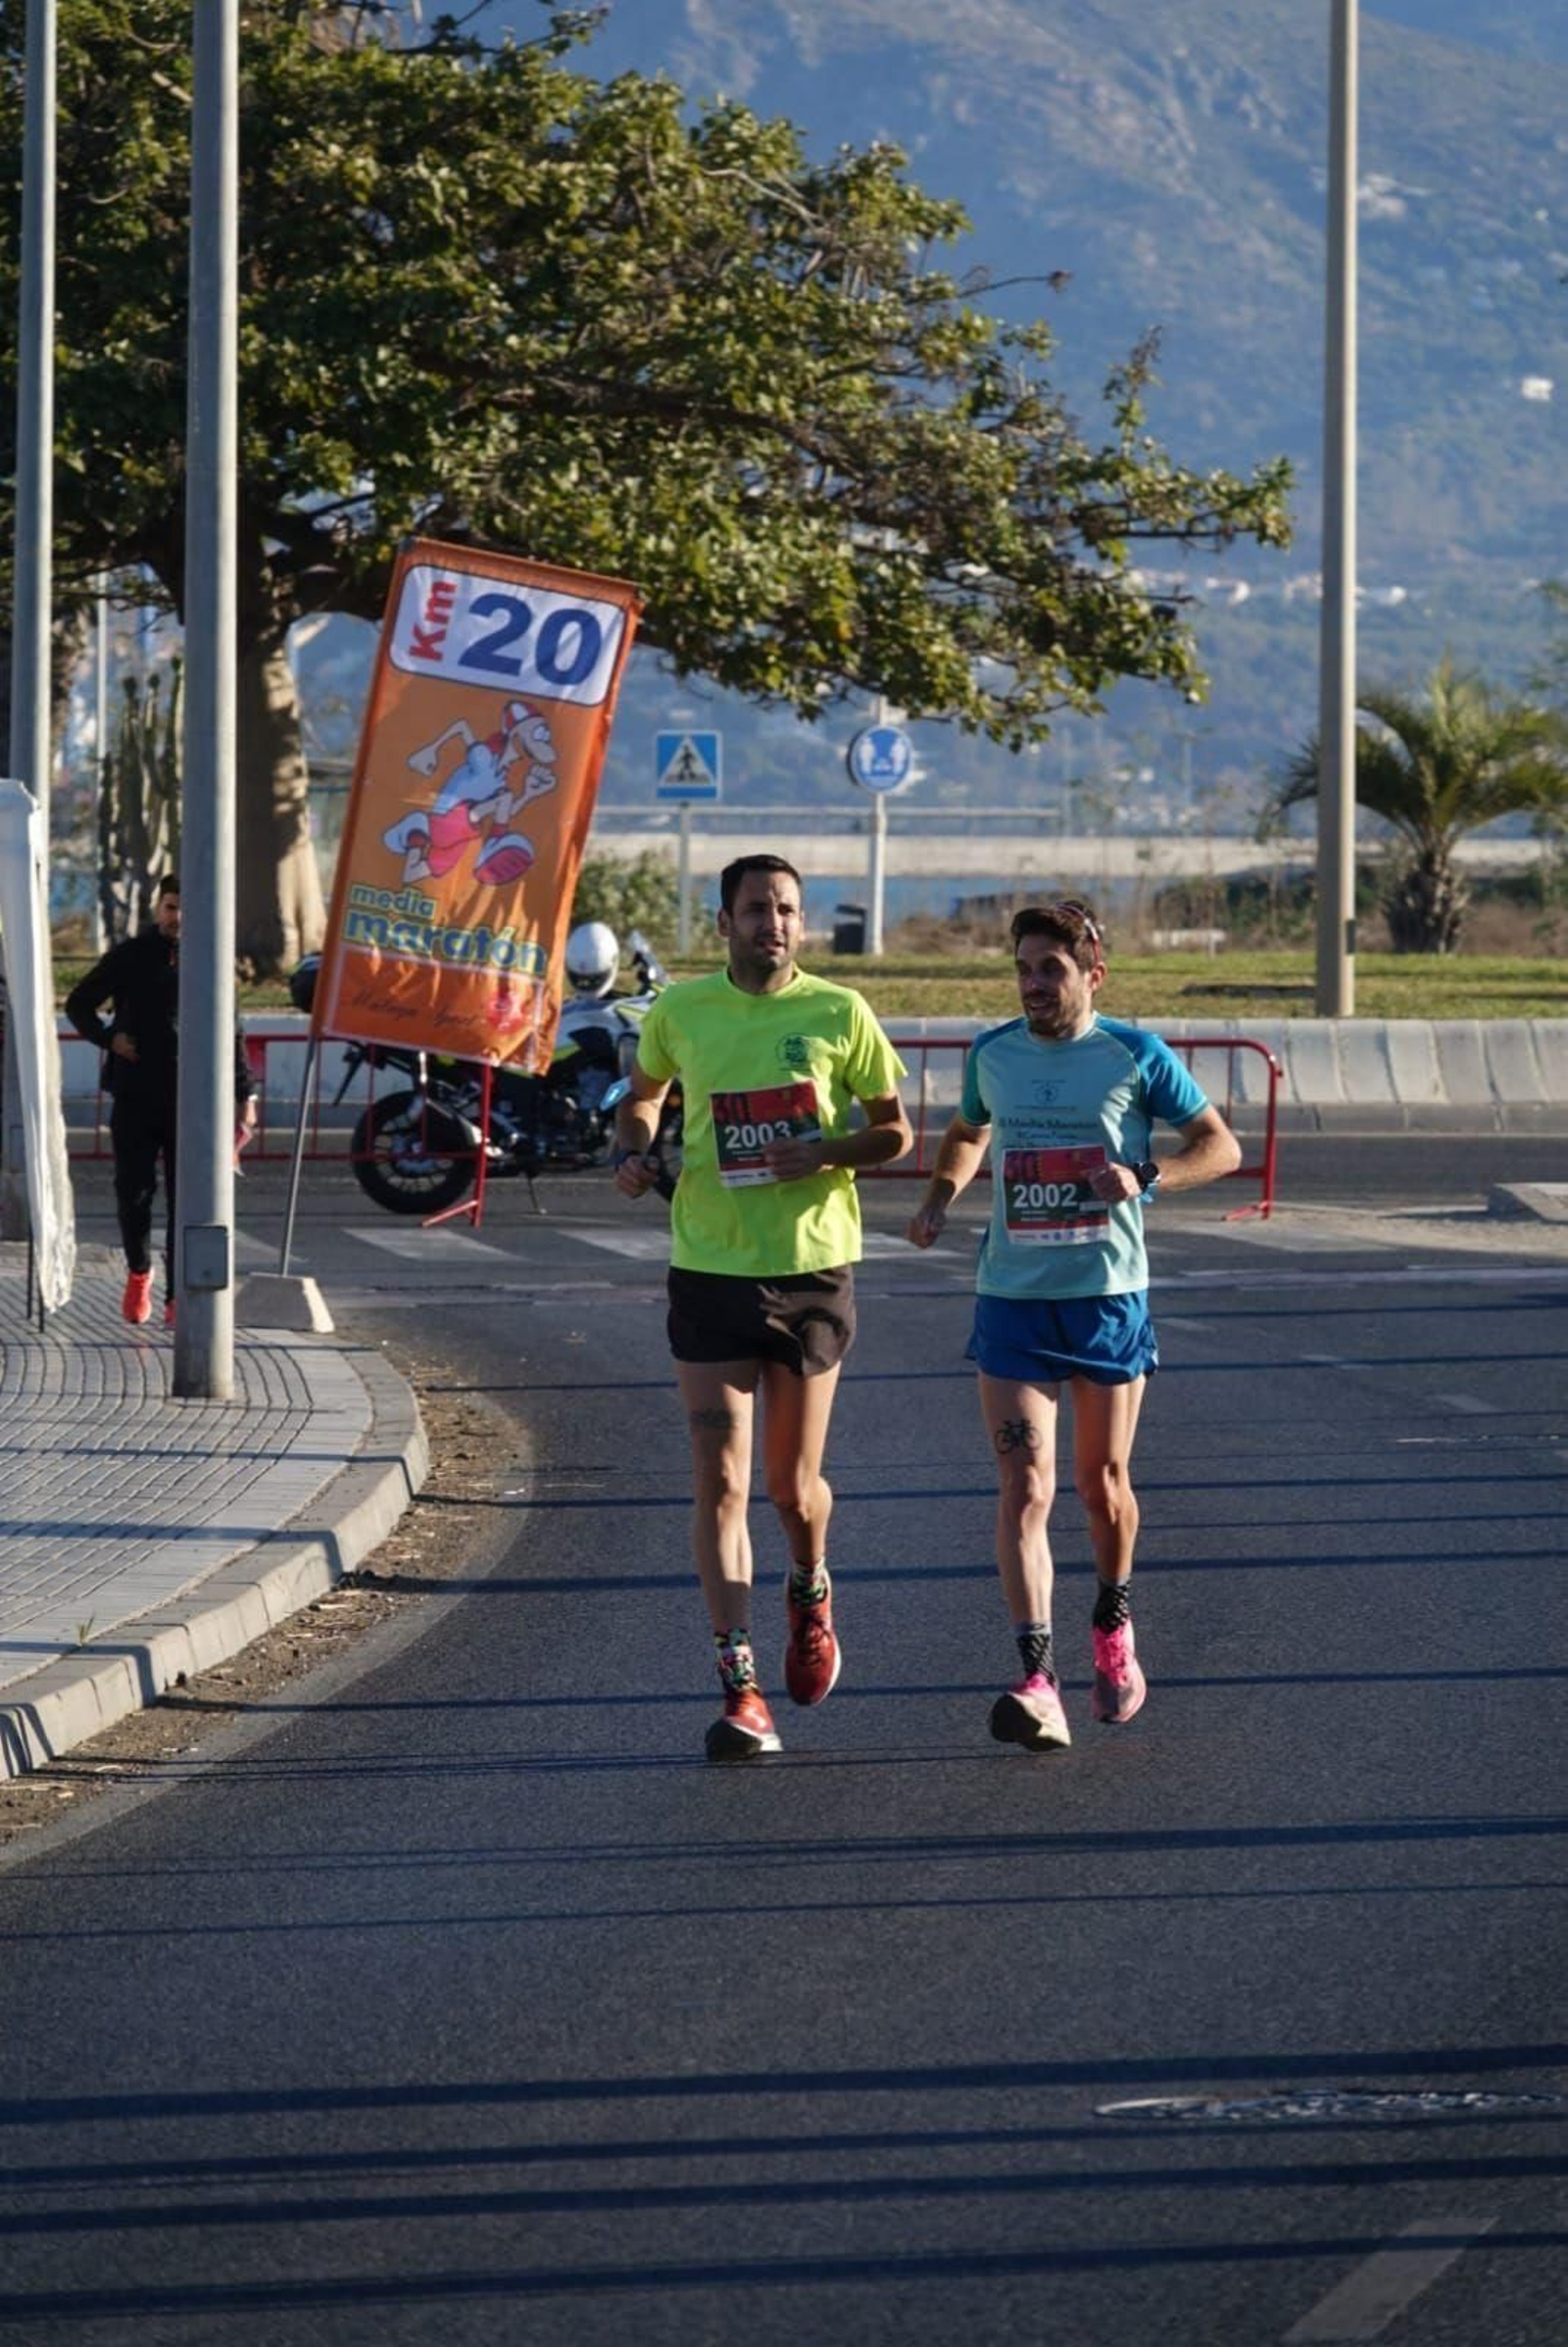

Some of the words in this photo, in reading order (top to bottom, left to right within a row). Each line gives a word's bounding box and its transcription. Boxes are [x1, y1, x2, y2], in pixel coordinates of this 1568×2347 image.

[410, 580, 458, 661] Km
[458, 593, 602, 685] 20
[350, 884, 436, 919] media
[344, 909, 547, 976] maratón
[724, 1120, 792, 1149] 2003
[1012, 1183, 1078, 1208] 2002
